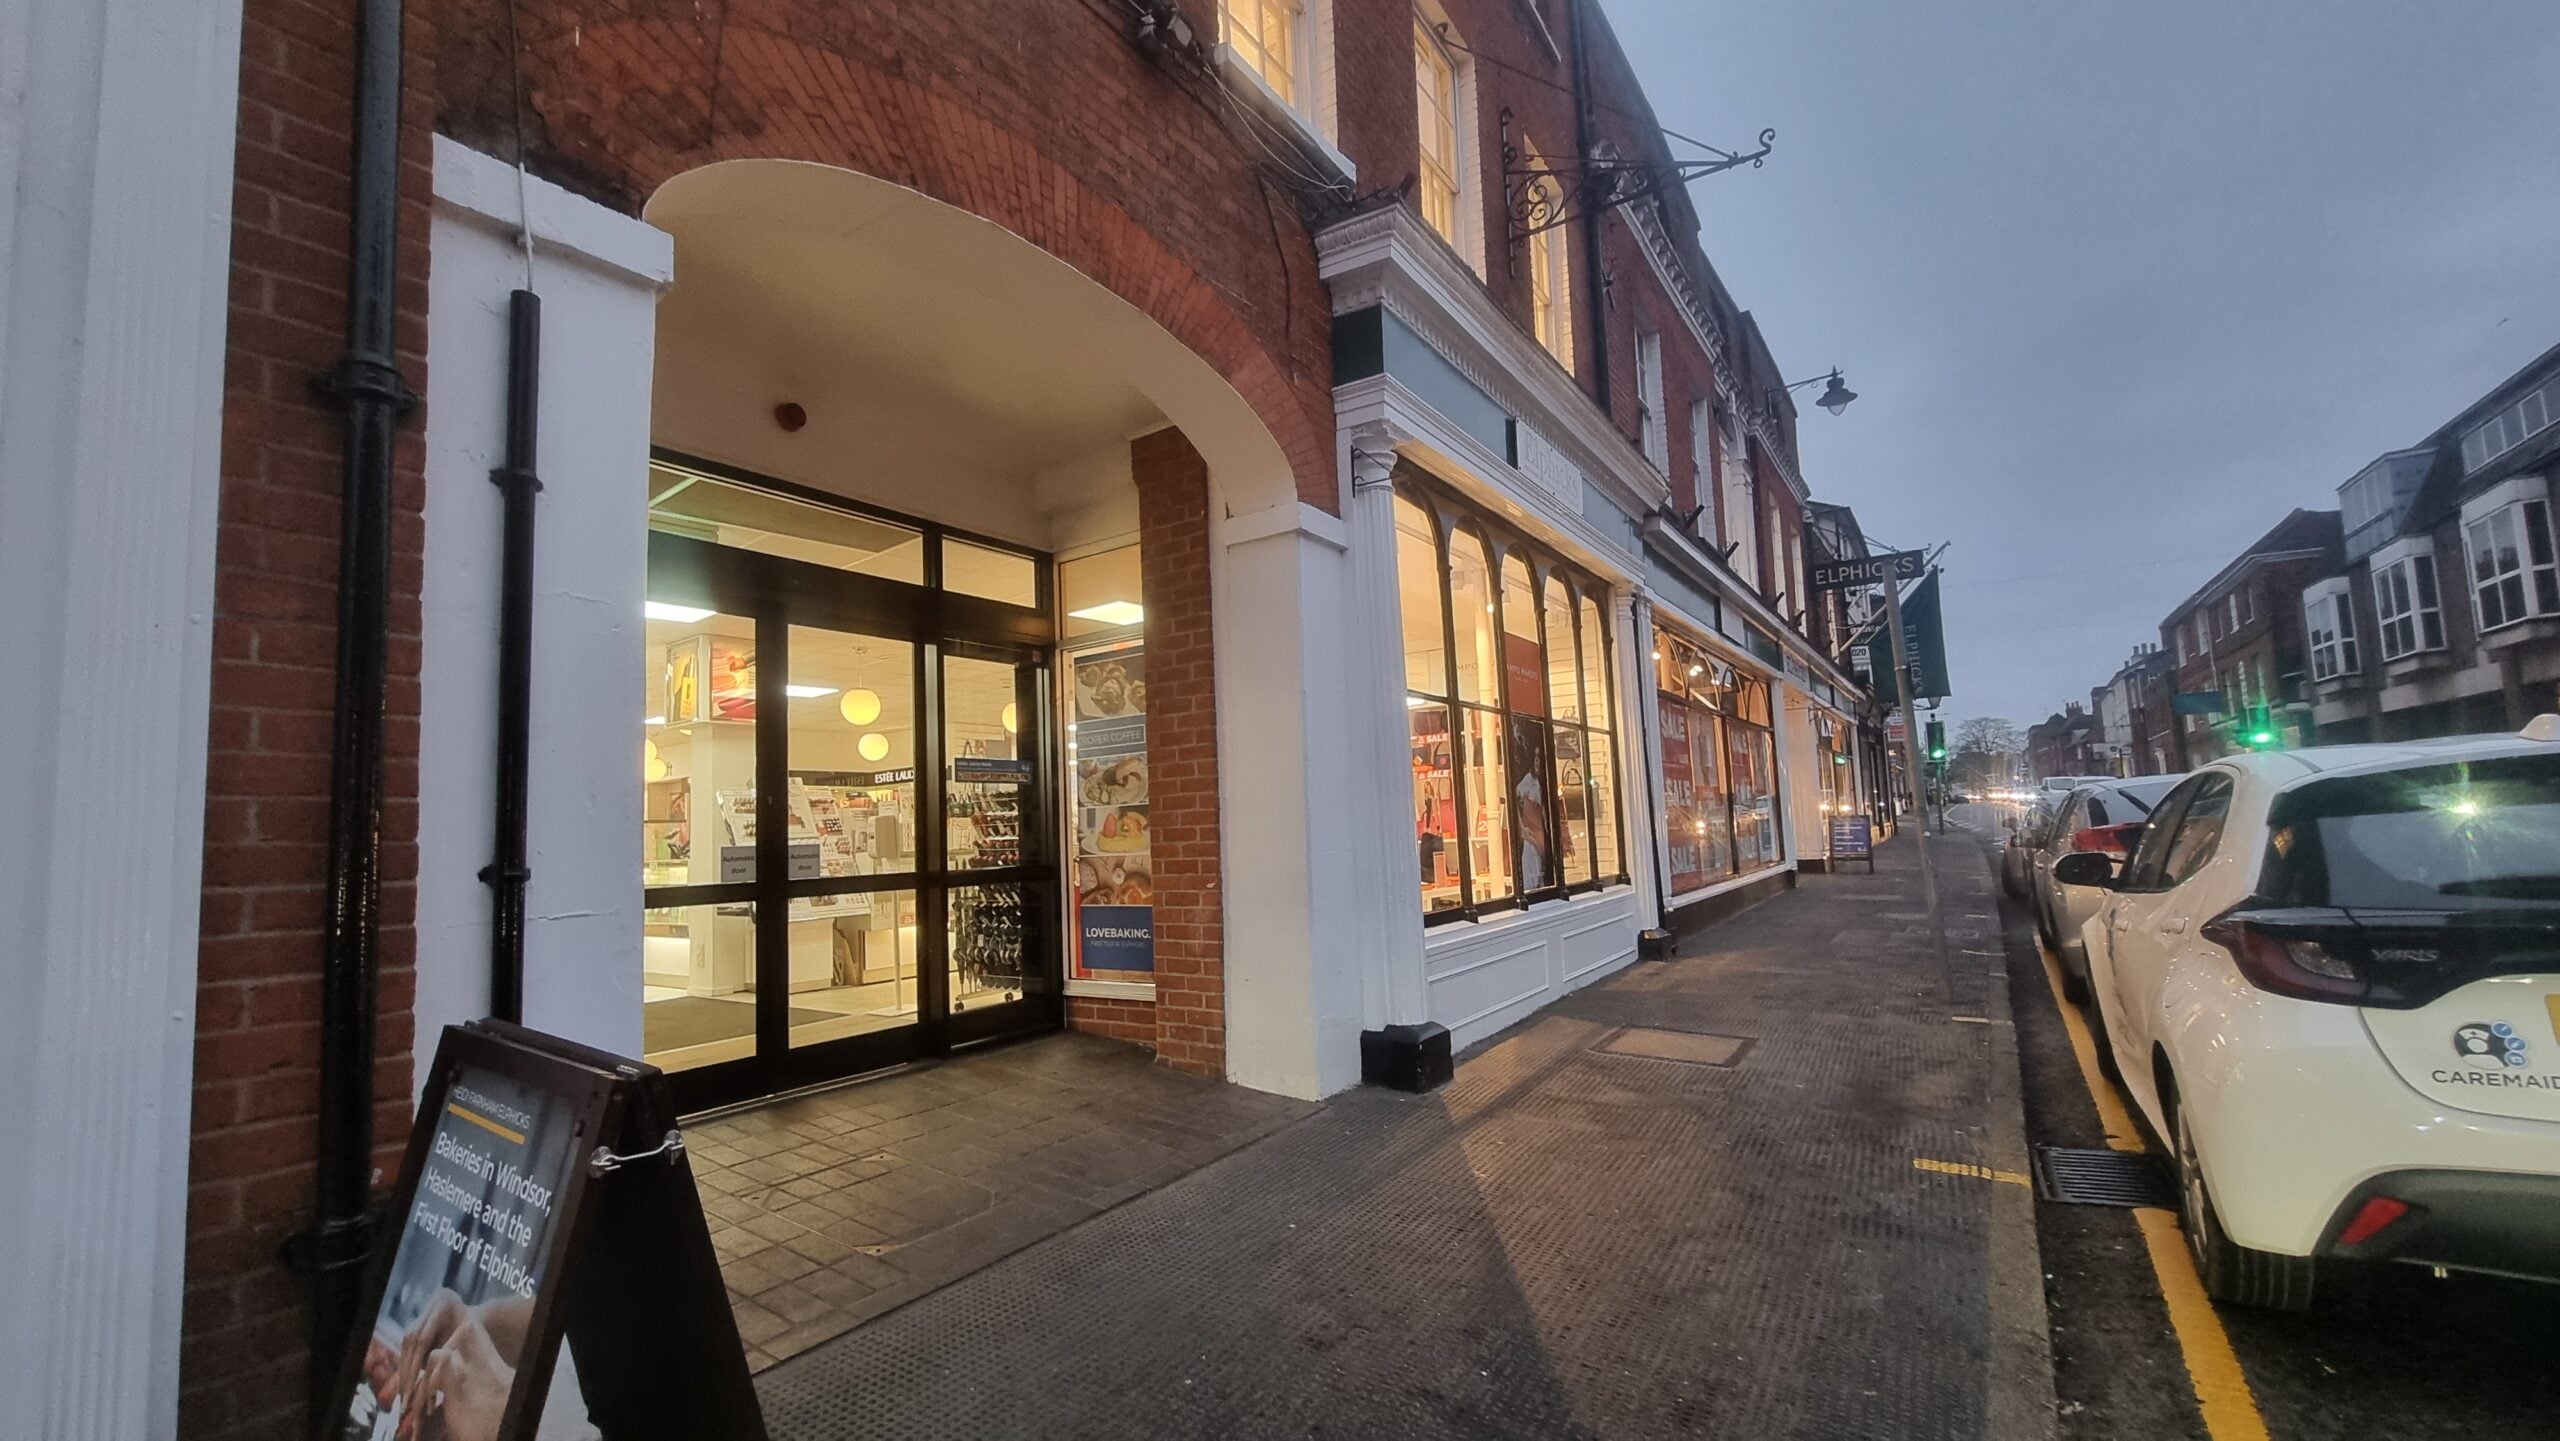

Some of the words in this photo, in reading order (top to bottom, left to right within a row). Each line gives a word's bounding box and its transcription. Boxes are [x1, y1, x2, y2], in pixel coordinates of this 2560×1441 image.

[1661, 709, 1686, 741] SALE
[1426, 733, 1448, 743] SALE
[1427, 769, 1450, 778] SALE
[1664, 777, 1691, 807] SALE
[722, 853, 755, 863] Automatic
[798, 864, 812, 872] door
[1671, 846, 1697, 874] SALE
[731, 866, 747, 874] door
[1085, 927, 1151, 940] LOVEBAKING.
[436, 1132, 483, 1174] Bakeries
[481, 1153, 495, 1181] in
[496, 1160, 552, 1217] Windsor,
[424, 1166, 483, 1218] Haslemere
[482, 1204, 511, 1234] and
[508, 1215, 532, 1247] the
[414, 1202, 439, 1236] First
[437, 1216, 468, 1253] Floor
[466, 1238, 483, 1264] of
[479, 1243, 535, 1299] Elphicks
